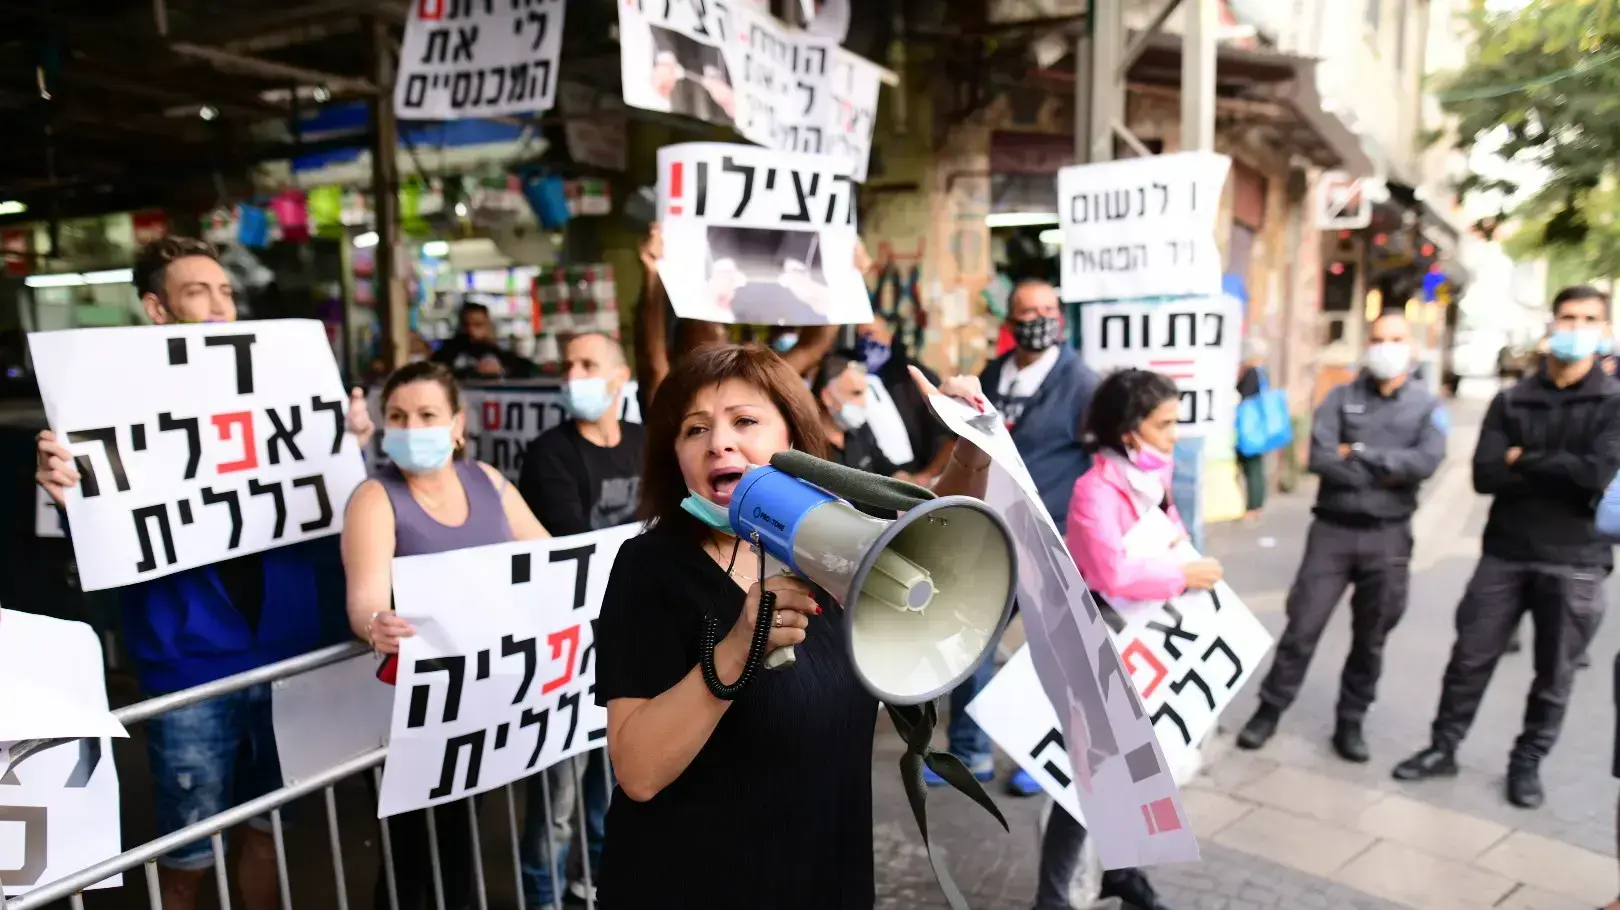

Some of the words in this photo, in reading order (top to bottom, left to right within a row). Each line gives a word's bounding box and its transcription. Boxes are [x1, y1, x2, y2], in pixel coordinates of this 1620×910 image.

[422, 26, 478, 63] את
[514, 12, 547, 51] לי
[404, 60, 551, 108] המכנסיים
[669, 156, 856, 226] הצילו!
[1071, 182, 1168, 224] לנשום
[167, 334, 256, 394] די
[67, 395, 346, 498] לאפליה
[132, 474, 333, 573] כללית
[511, 543, 597, 610] די
[407, 618, 600, 729] פליה
